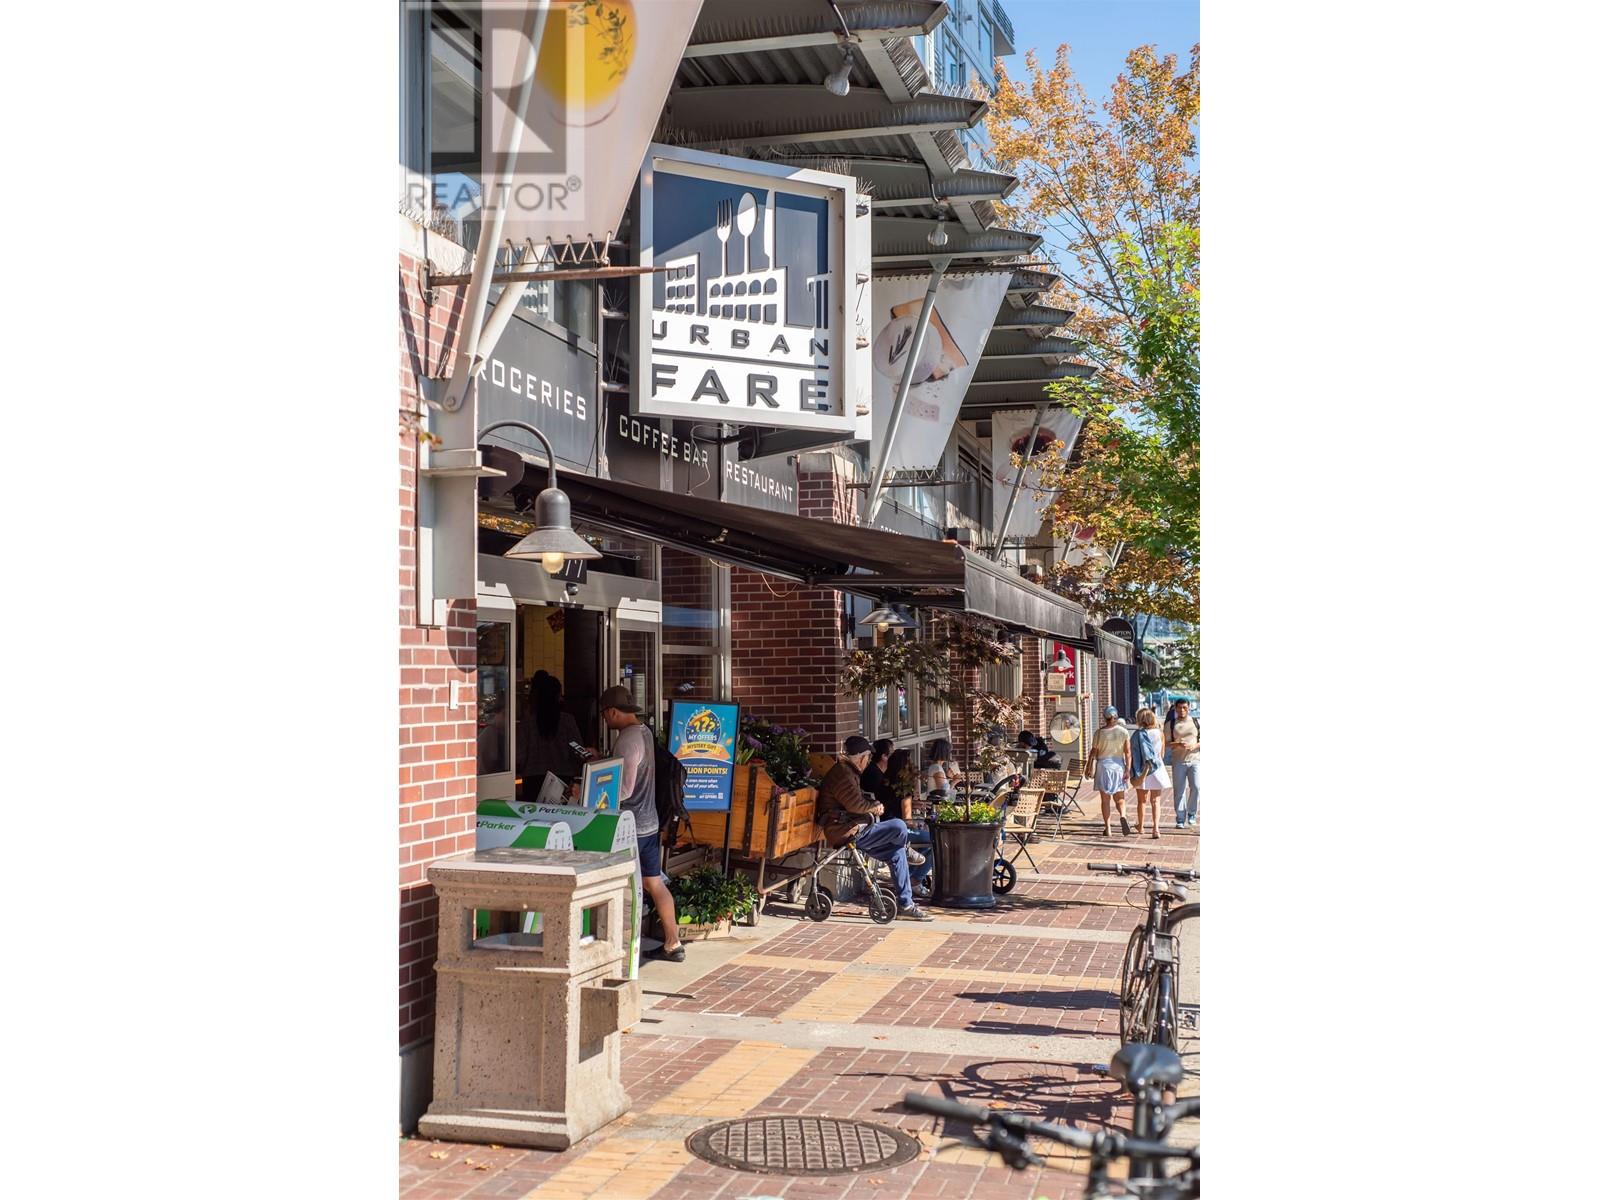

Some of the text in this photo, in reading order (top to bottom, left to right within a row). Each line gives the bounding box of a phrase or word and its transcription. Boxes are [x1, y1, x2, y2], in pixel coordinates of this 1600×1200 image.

[652, 319, 829, 357] URBAN
[652, 363, 829, 411] FARE
[618, 413, 709, 468] COFFEE BAR
[725, 460, 794, 504] RESTAURANT
[703, 767, 728, 775] POINTS!
[538, 806, 589, 817] PetParker
